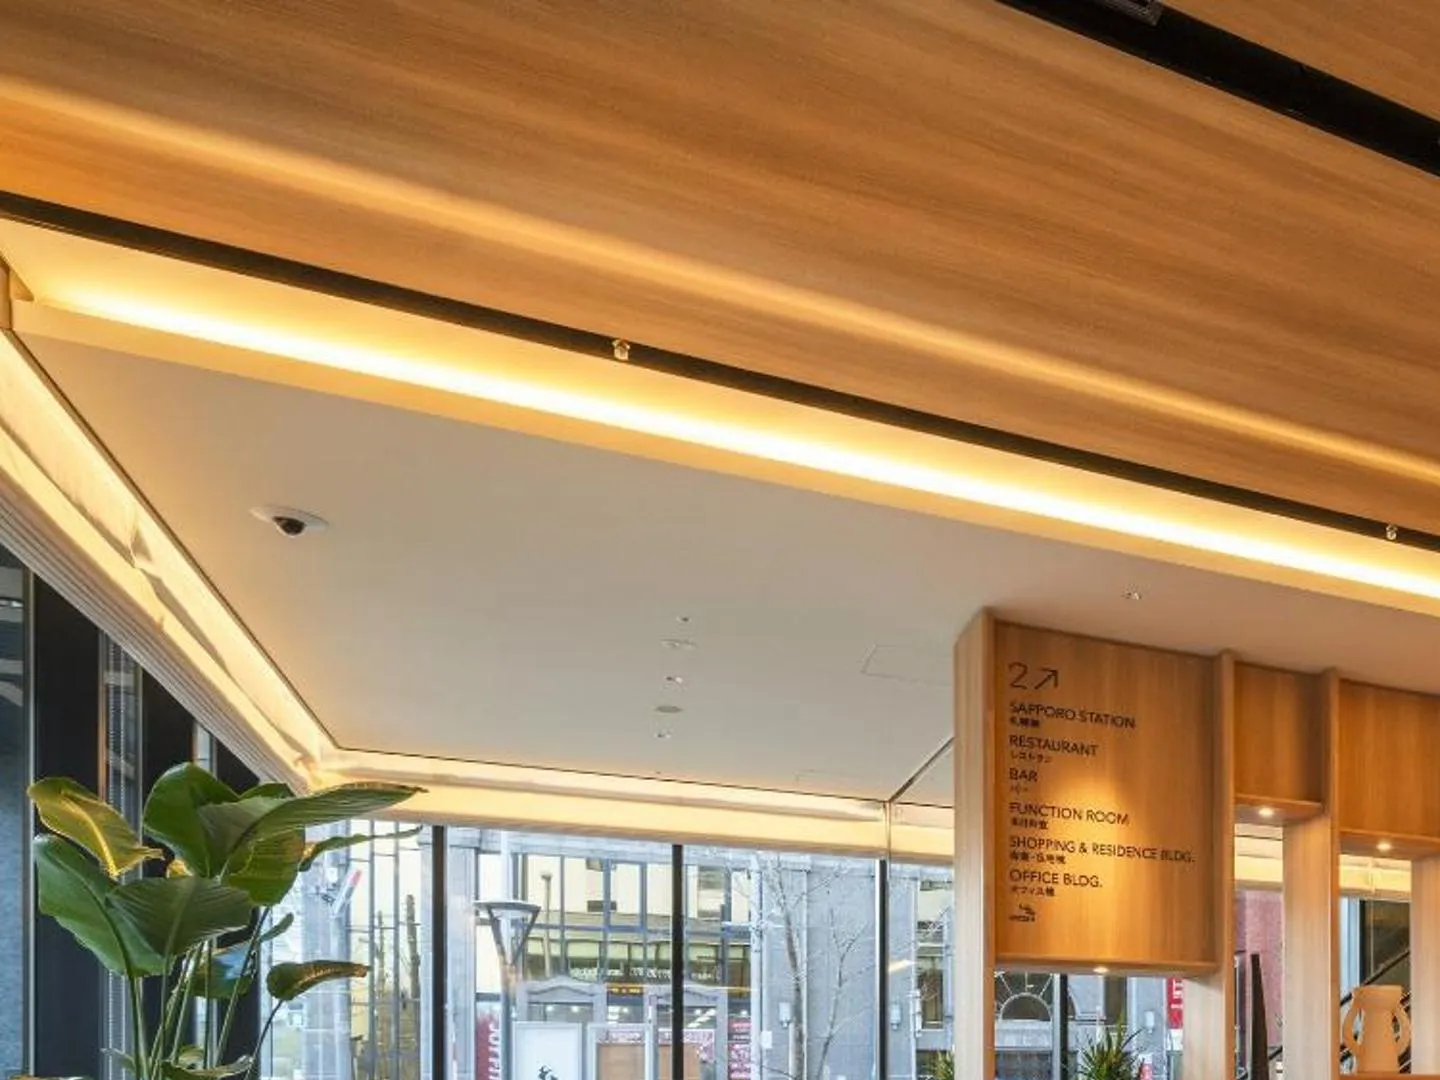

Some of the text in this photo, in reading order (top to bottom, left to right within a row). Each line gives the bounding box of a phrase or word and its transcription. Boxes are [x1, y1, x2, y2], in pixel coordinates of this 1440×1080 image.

[1009, 662, 1027, 690] 2
[1009, 700, 1137, 729] SAPPORO STATION
[1009, 735, 1099, 756] RESTAURANT
[1009, 767, 1038, 782] BAR
[1009, 801, 1129, 825] FUNCTION ROOM
[1009, 836, 1075, 854] SHOPPING
[1078, 842, 1088, 854] &
[1092, 842, 1157, 860] RESIDENCE
[1009, 868, 1103, 888] OFFICE BLDG.
